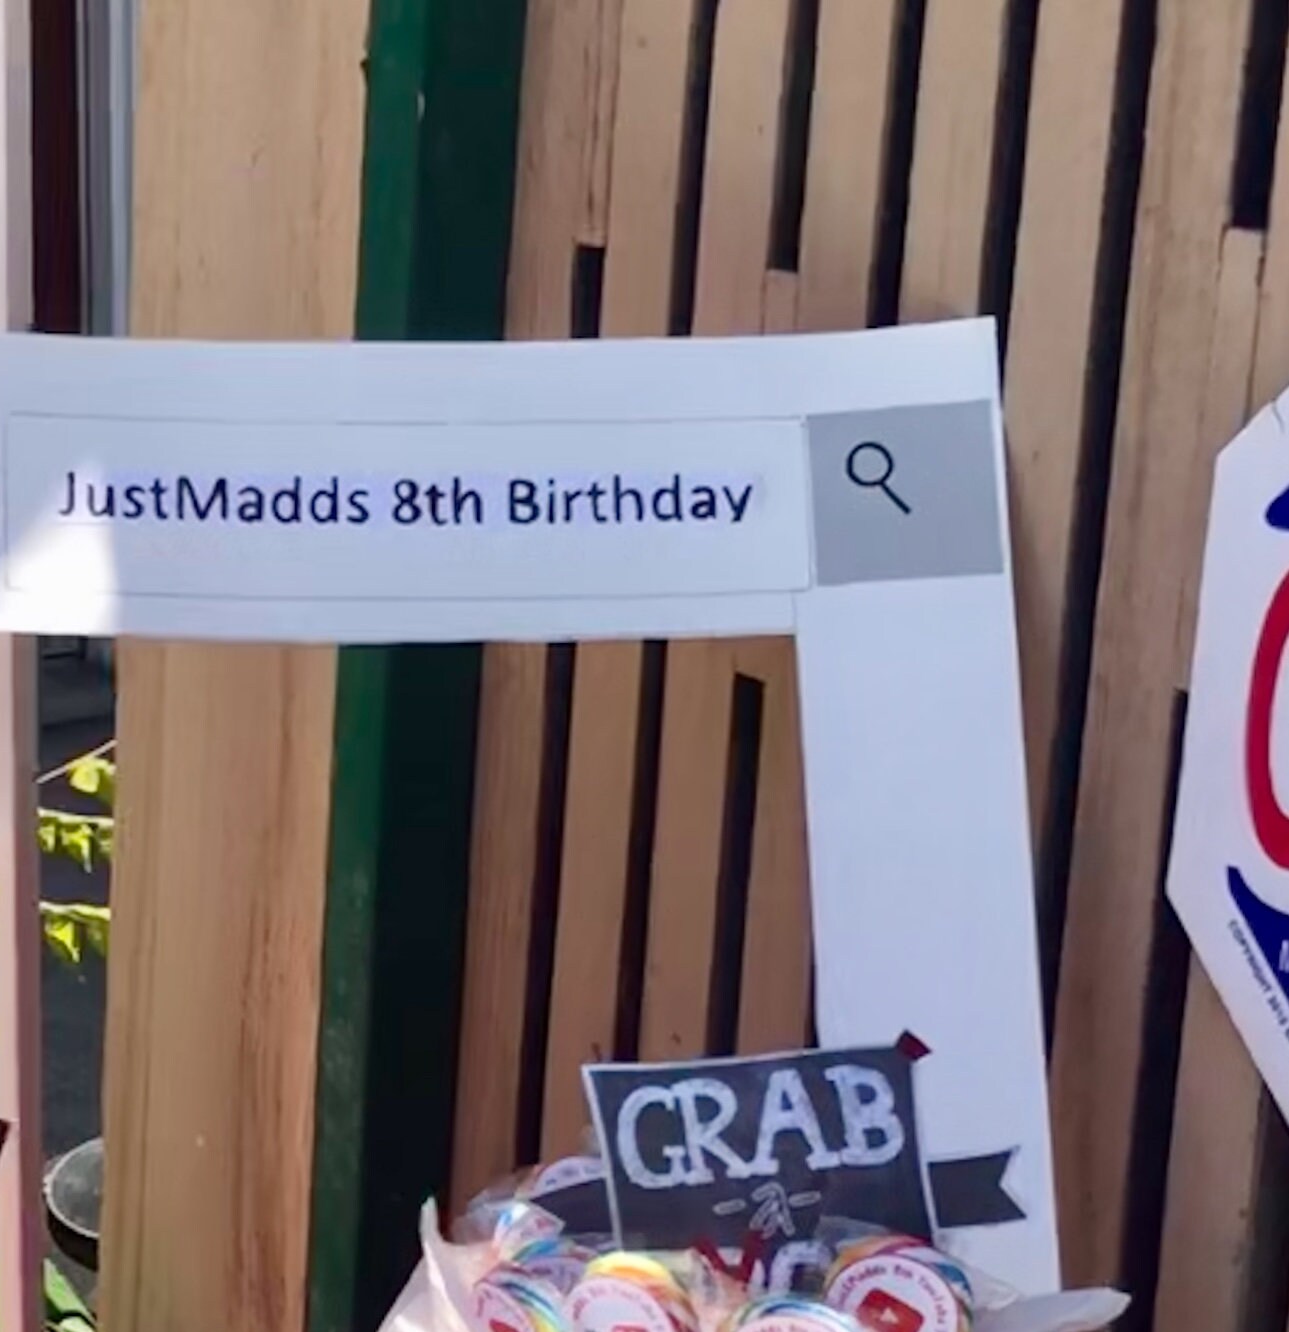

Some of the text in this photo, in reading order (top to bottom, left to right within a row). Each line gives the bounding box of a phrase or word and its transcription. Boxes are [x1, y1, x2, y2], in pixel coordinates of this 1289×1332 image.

[58, 472, 755, 526] JustMadds 8th Birthday
[616, 1064, 905, 1189] GRAB
